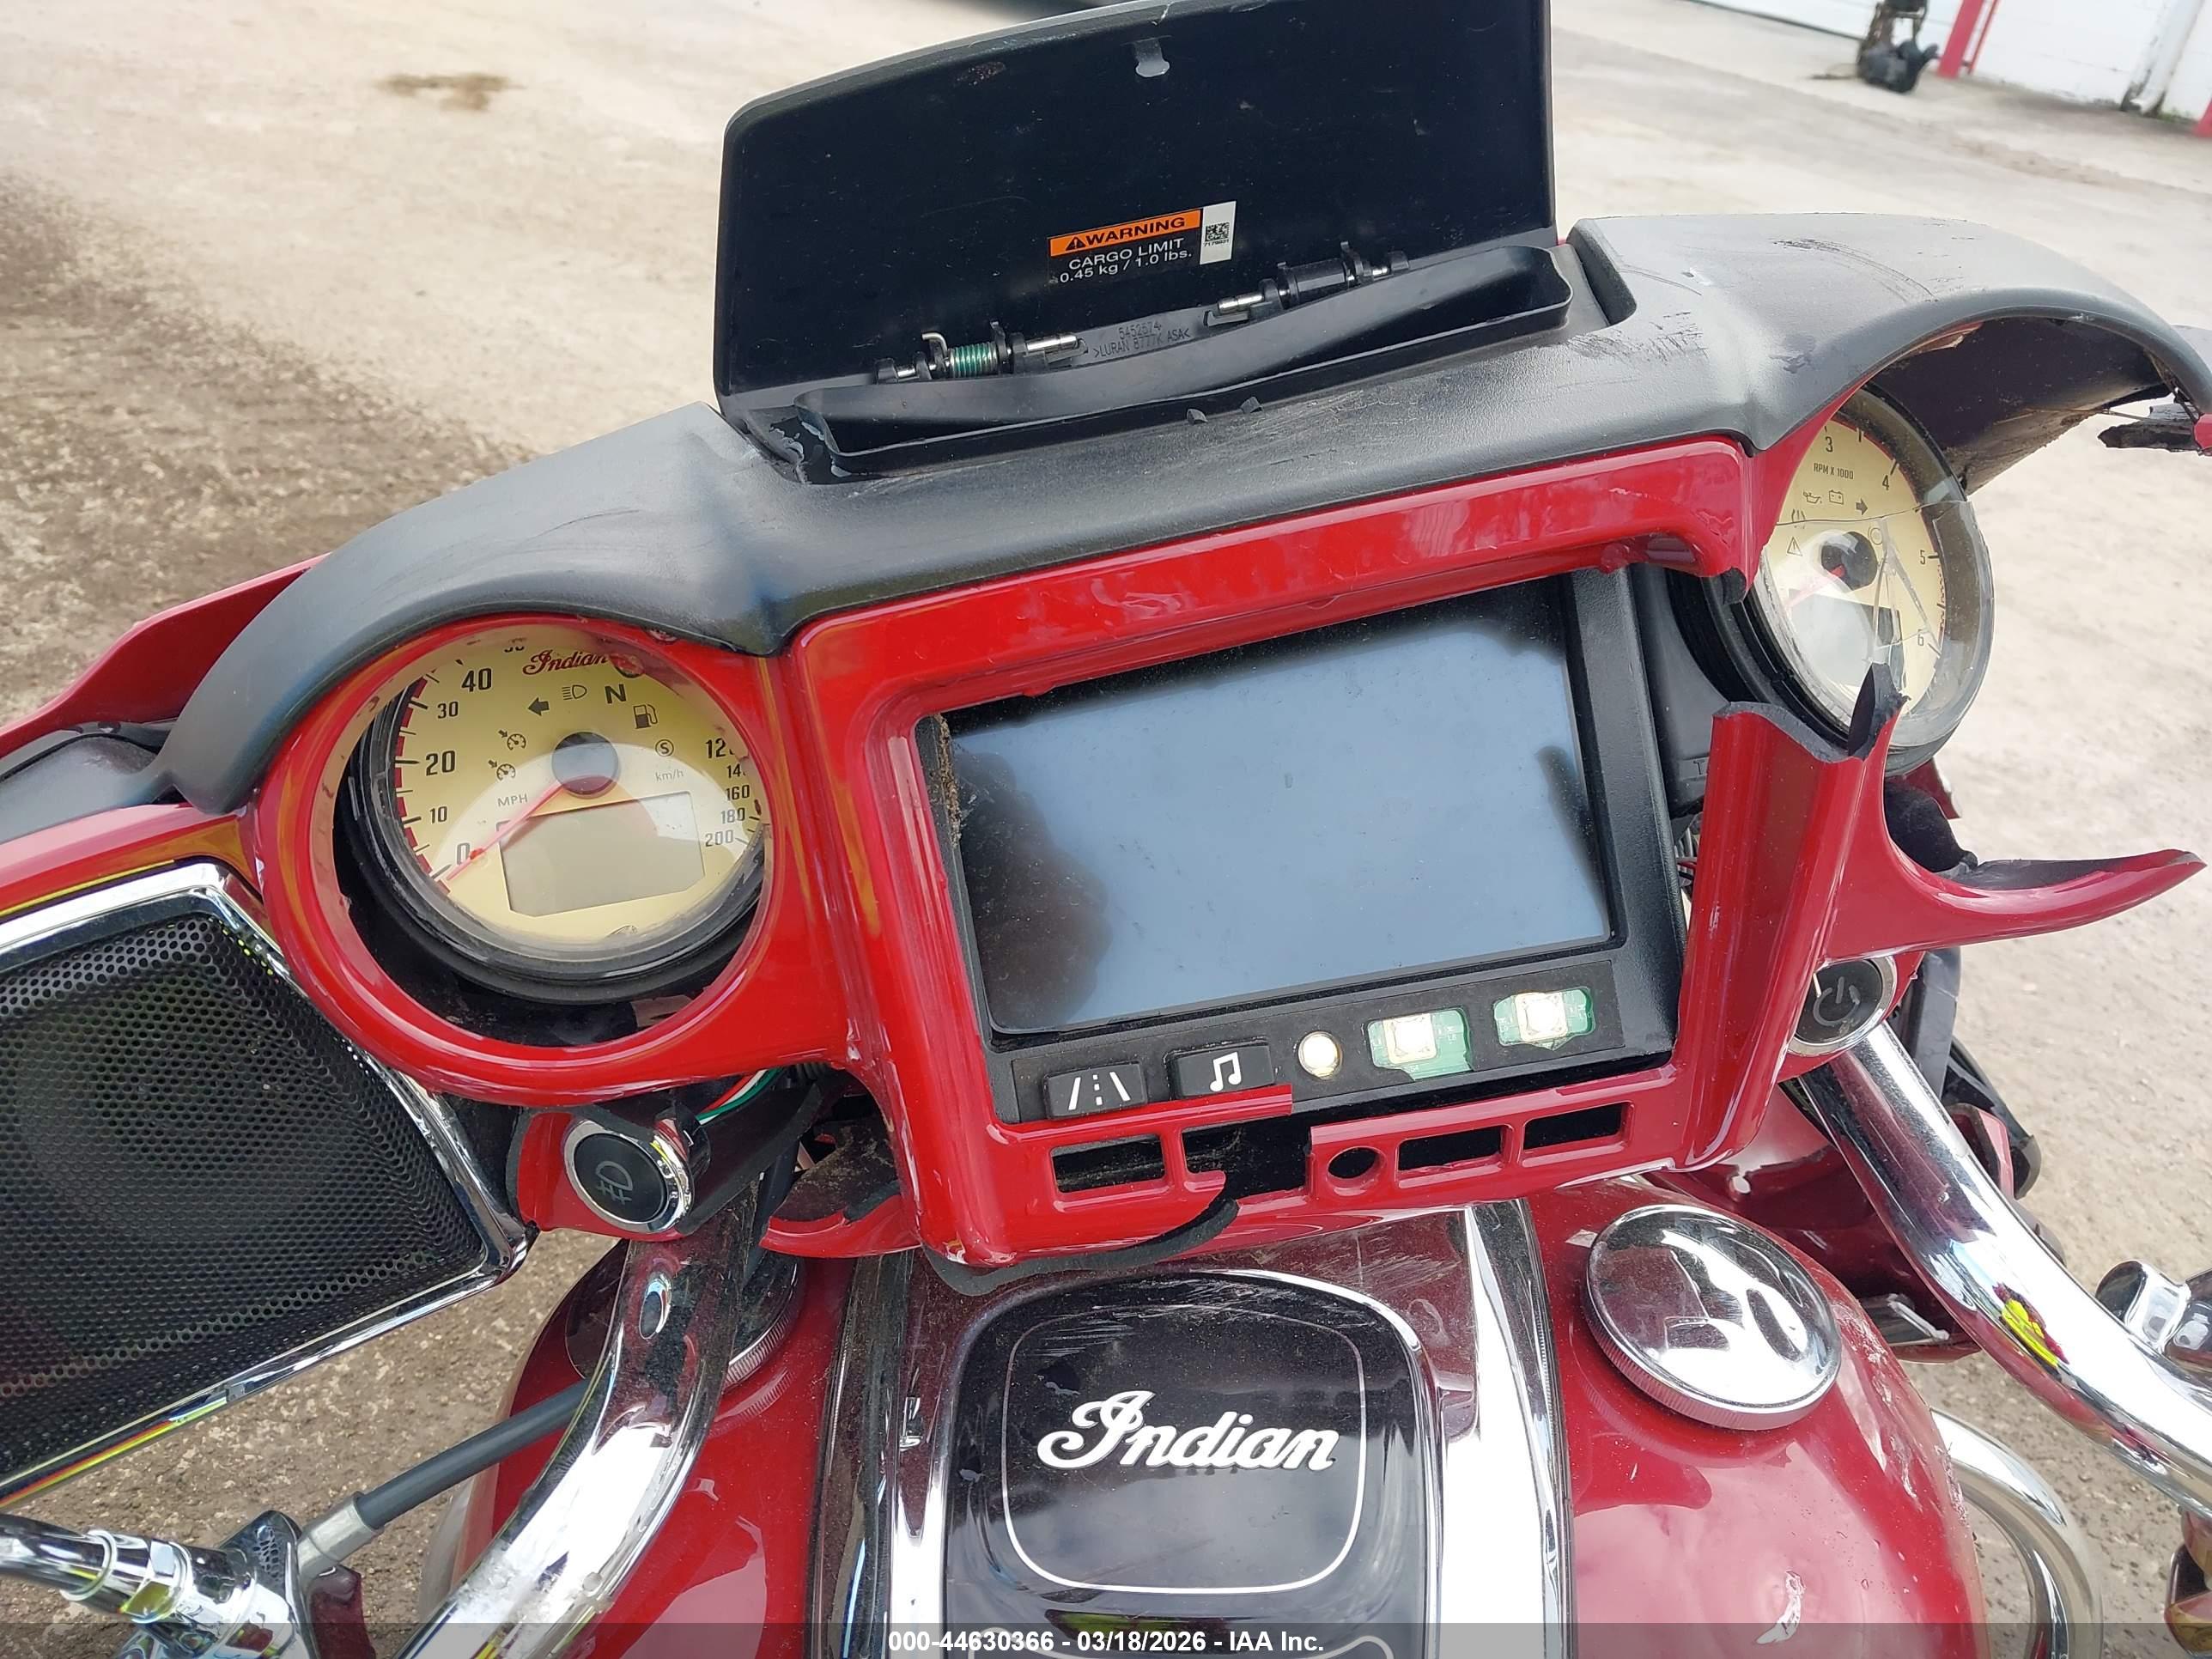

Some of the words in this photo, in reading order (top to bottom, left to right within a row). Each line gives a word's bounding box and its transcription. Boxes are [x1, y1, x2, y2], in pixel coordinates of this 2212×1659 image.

[1085, 217, 1185, 246] WARNING
[1068, 248, 1133, 270] CARGO
[1138, 238, 1184, 257] LIMIT
[1060, 267, 1094, 283] 0.45
[1099, 263, 1118, 275] kg
[1122, 259, 1130, 270] /
[1135, 254, 1159, 267] 1.0
[1164, 250, 1192, 262] lbs.
[1825, 436, 1833, 453] 3
[1813, 463, 1829, 475] RPM
[1830, 466, 1835, 476] X
[1837, 468, 1854, 480] 1000
[1881, 475, 1890, 490] 4
[1918, 549, 1926, 565] 5
[1916, 629, 1924, 647] 6
[522, 649, 608, 676] Indian
[461, 667, 492, 693] 40
[605, 684, 627, 704] N
[437, 701, 459, 720] 30
[705, 738, 735, 759] 12
[425, 750, 456, 777] 20
[726, 763, 746, 779] 14
[655, 769, 684, 782] km/h
[497, 793, 528, 809] MPH
[726, 785, 750, 801] 160
[429, 805, 447, 823] 10
[720, 807, 745, 824] 180
[705, 830, 734, 848] 200
[455, 842, 471, 866] 0
[1037, 1390, 1340, 1472] Indian
